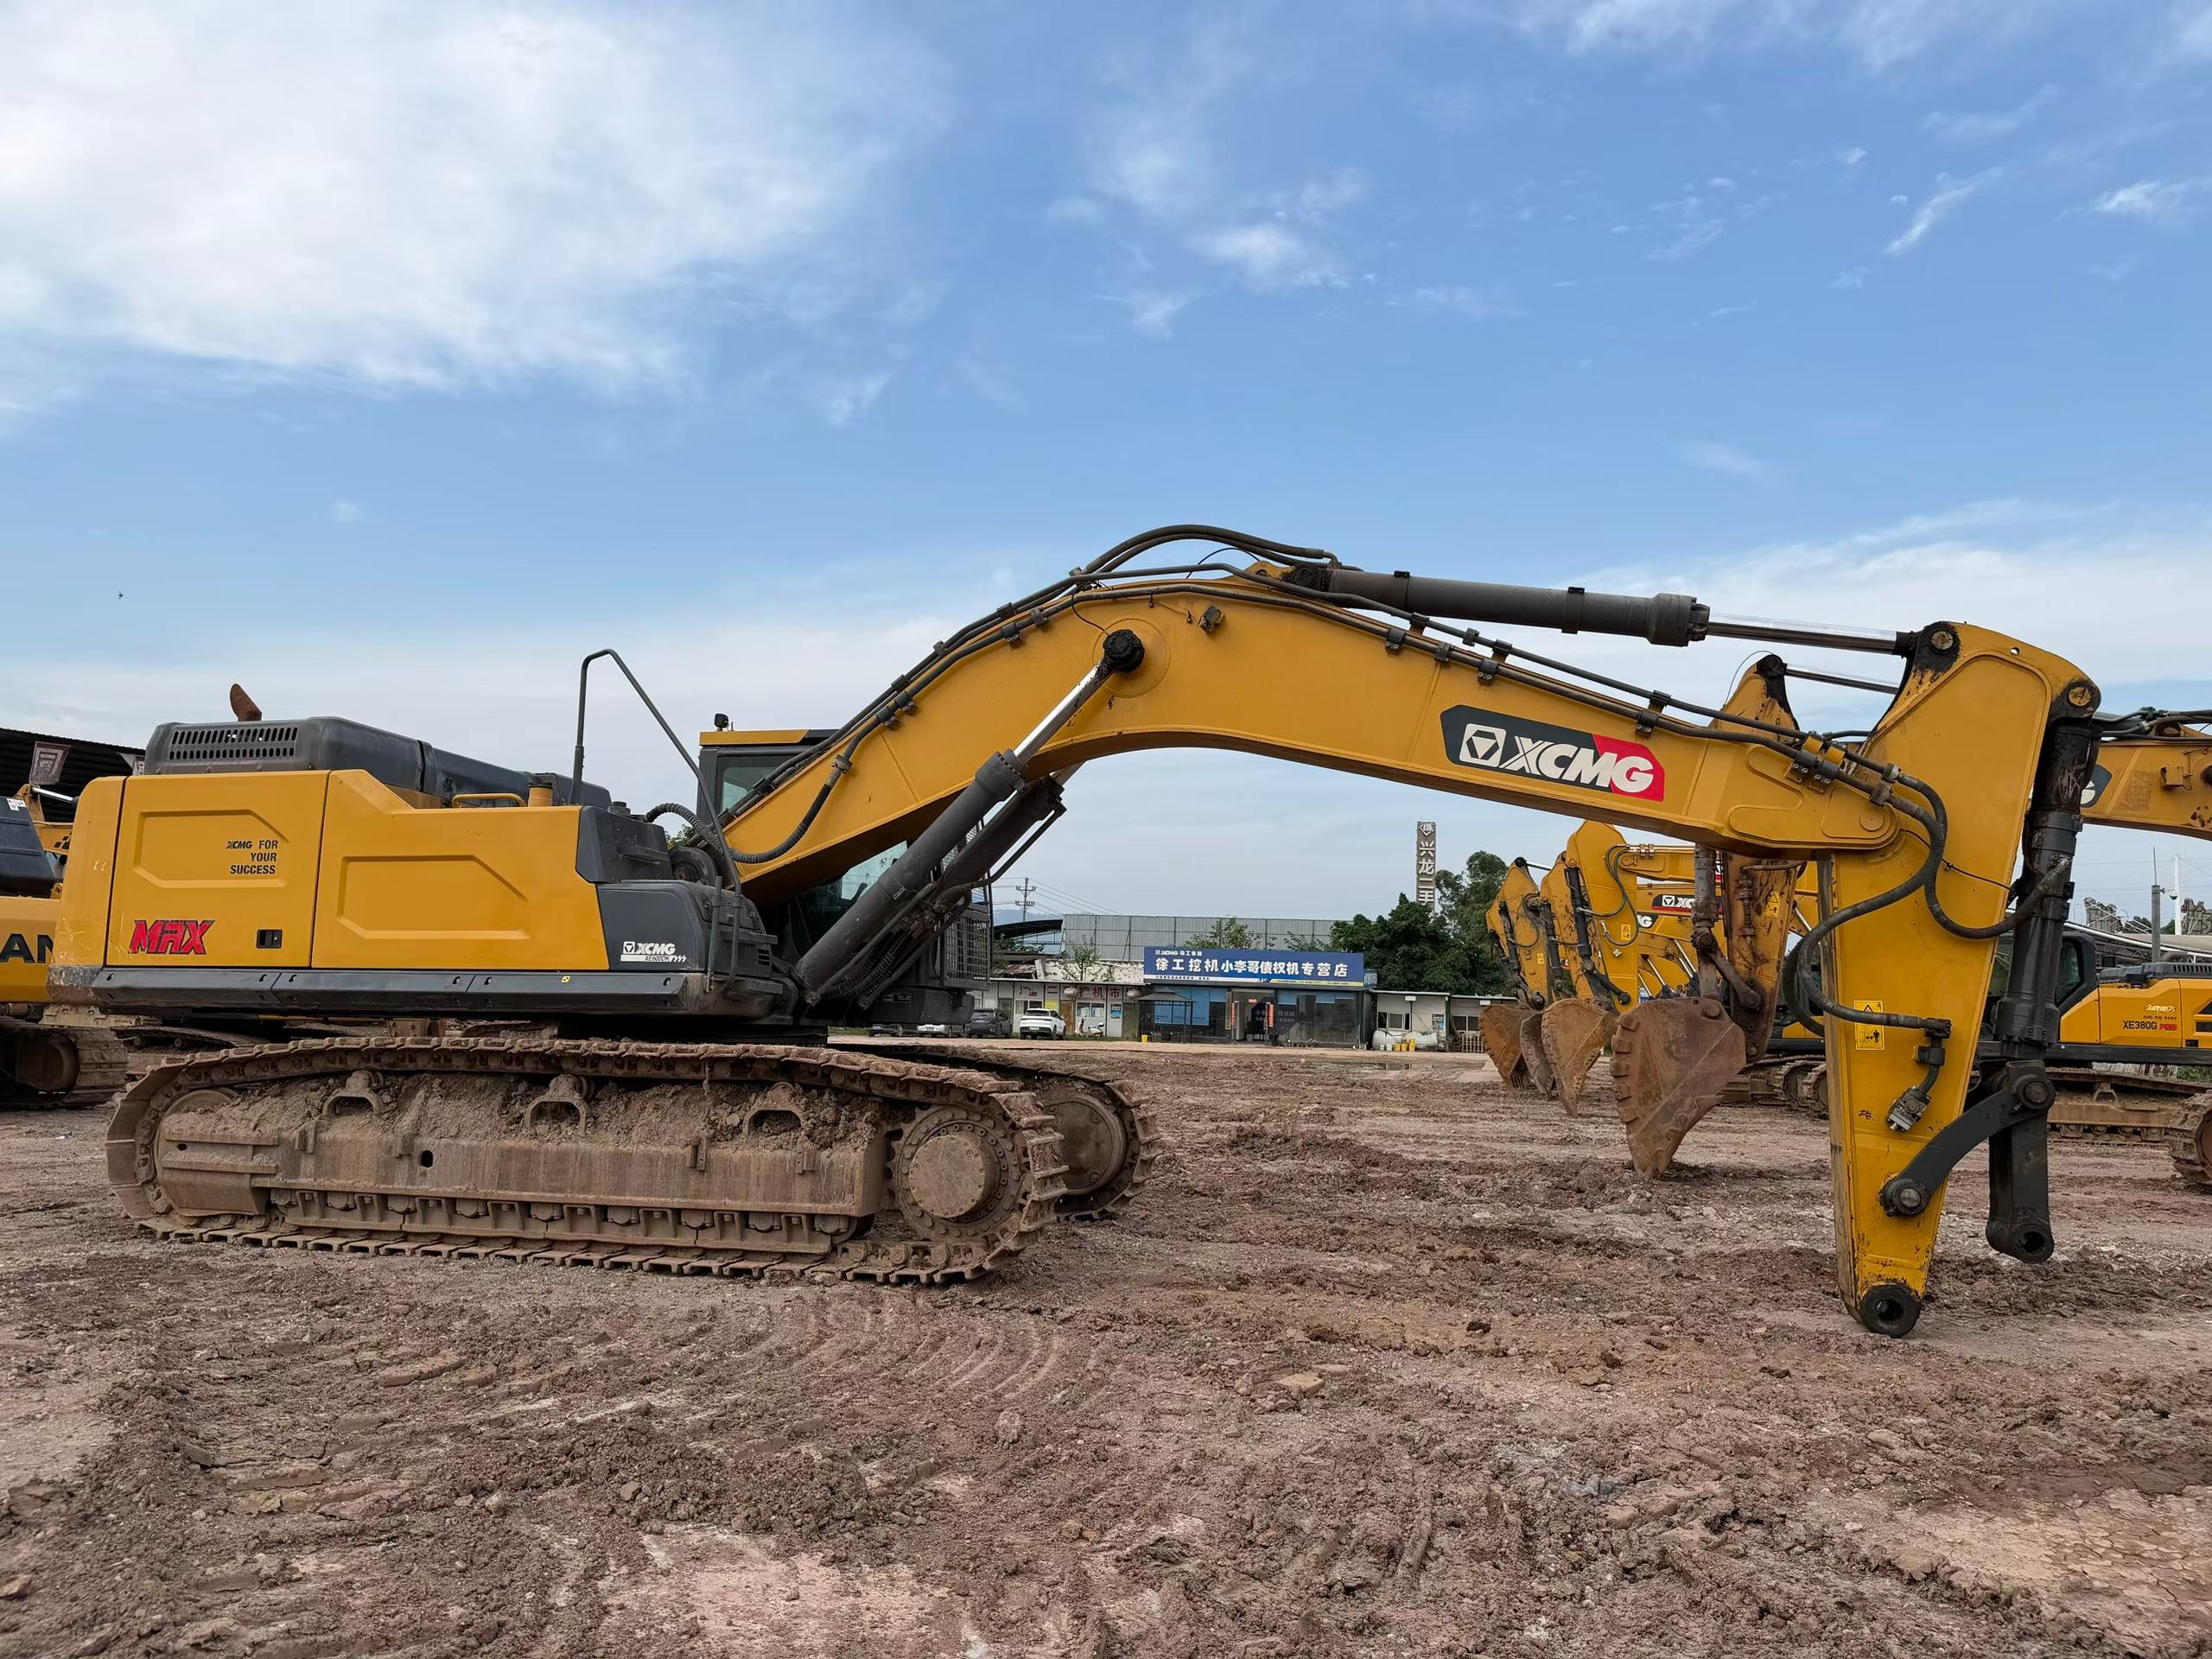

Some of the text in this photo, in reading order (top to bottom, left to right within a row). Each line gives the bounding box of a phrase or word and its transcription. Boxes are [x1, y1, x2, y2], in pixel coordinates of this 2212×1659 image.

[1499, 736, 1654, 792] XCMG
[226, 841, 278, 849] XCMG FOR
[251, 853, 276, 861] YOUR
[230, 865, 276, 874] SUCCESS
[129, 920, 215, 955] MAX
[634, 943, 676, 955] XCMG
[2123, 1020, 2157, 1030] XE380G
